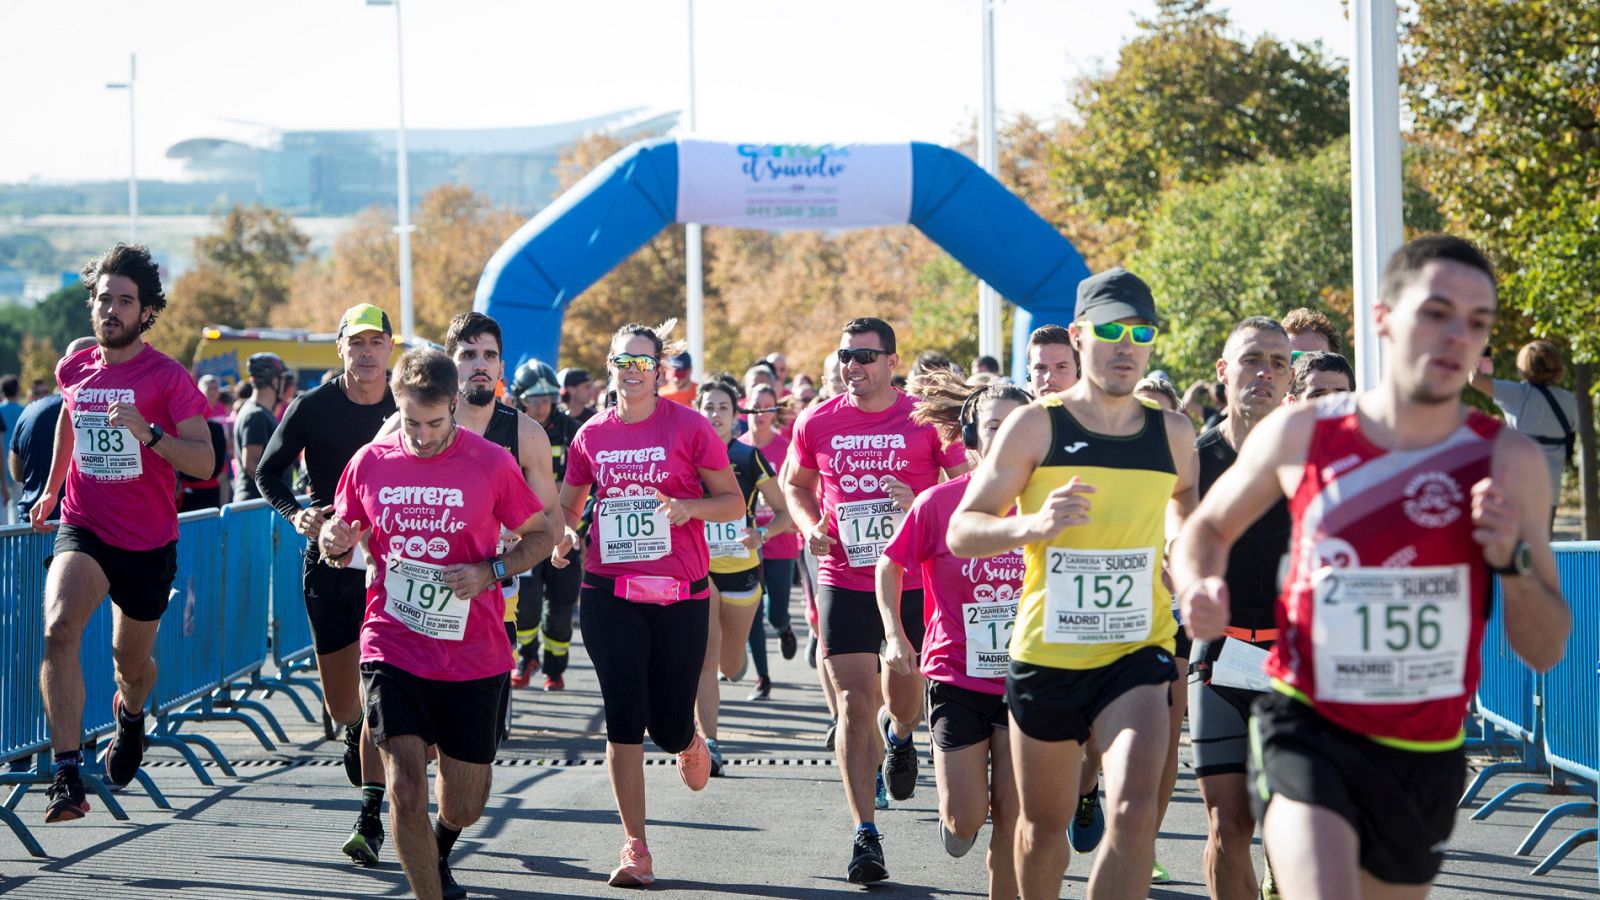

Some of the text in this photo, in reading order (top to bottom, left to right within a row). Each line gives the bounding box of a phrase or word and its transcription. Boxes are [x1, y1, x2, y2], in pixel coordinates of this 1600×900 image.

[73, 388, 136, 404] carrera
[87, 429, 124, 453] 183
[831, 434, 906, 450] carrera
[81, 455, 105, 463] MADRID
[595, 446, 666, 464] carrera
[829, 450, 845, 473] el
[378, 486, 464, 507] carrera
[403, 507, 435, 515] contra
[376, 506, 394, 534] el
[615, 512, 655, 538] 105
[705, 522, 736, 541] 116
[852, 515, 894, 542] 146
[410, 542, 423, 552] 5K
[608, 541, 633, 550] MADRID
[848, 546, 872, 554] MADRID
[1106, 555, 1147, 570] SUICIDIO
[406, 578, 454, 611] 197
[976, 589, 993, 598] 10K
[1001, 590, 1009, 599] 5K
[1073, 574, 1134, 609] 152
[980, 607, 1009, 615] CARRERA
[1058, 614, 1100, 625] MADRID
[1355, 603, 1441, 652] 156
[988, 621, 1015, 650] 12
[978, 654, 1010, 662] MADRID
